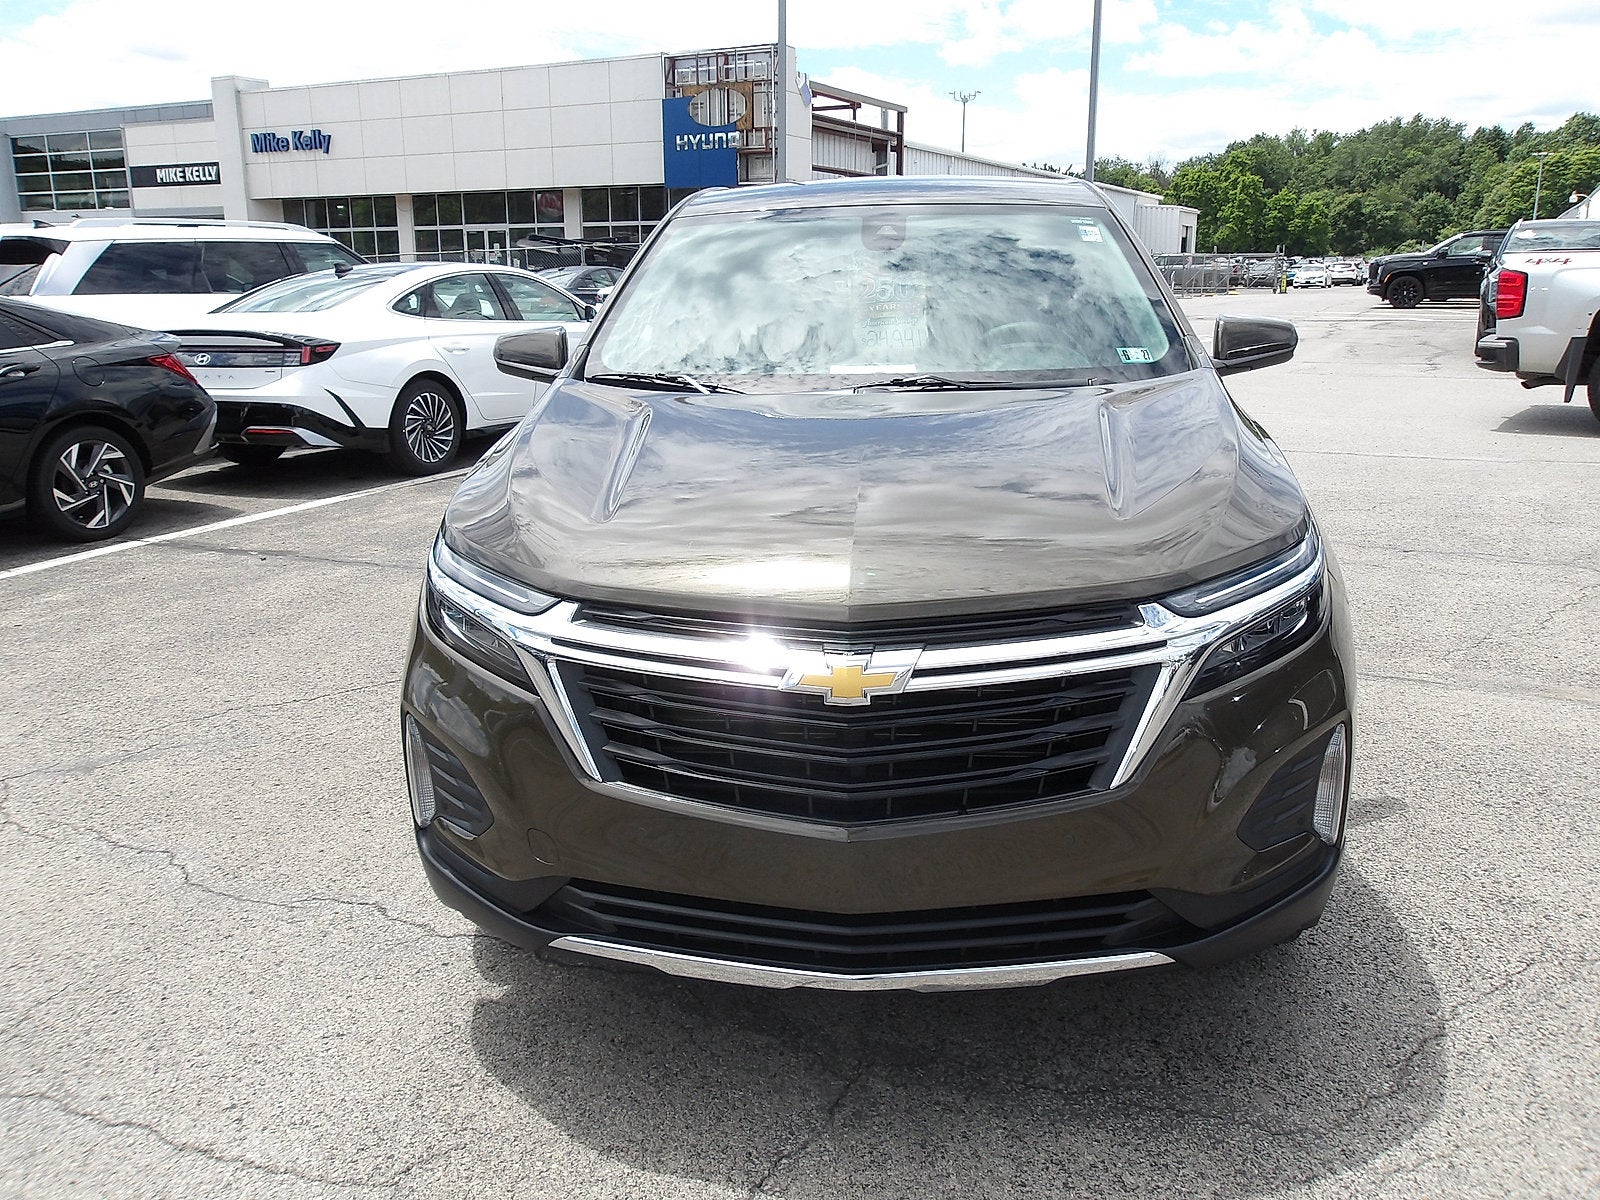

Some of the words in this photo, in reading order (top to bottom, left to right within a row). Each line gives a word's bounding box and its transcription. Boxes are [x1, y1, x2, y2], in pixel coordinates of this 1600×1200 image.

[250, 132, 290, 154] Mike
[291, 129, 332, 154] Kelly
[156, 167, 184, 184] MIKE
[185, 165, 218, 182] KELLY
